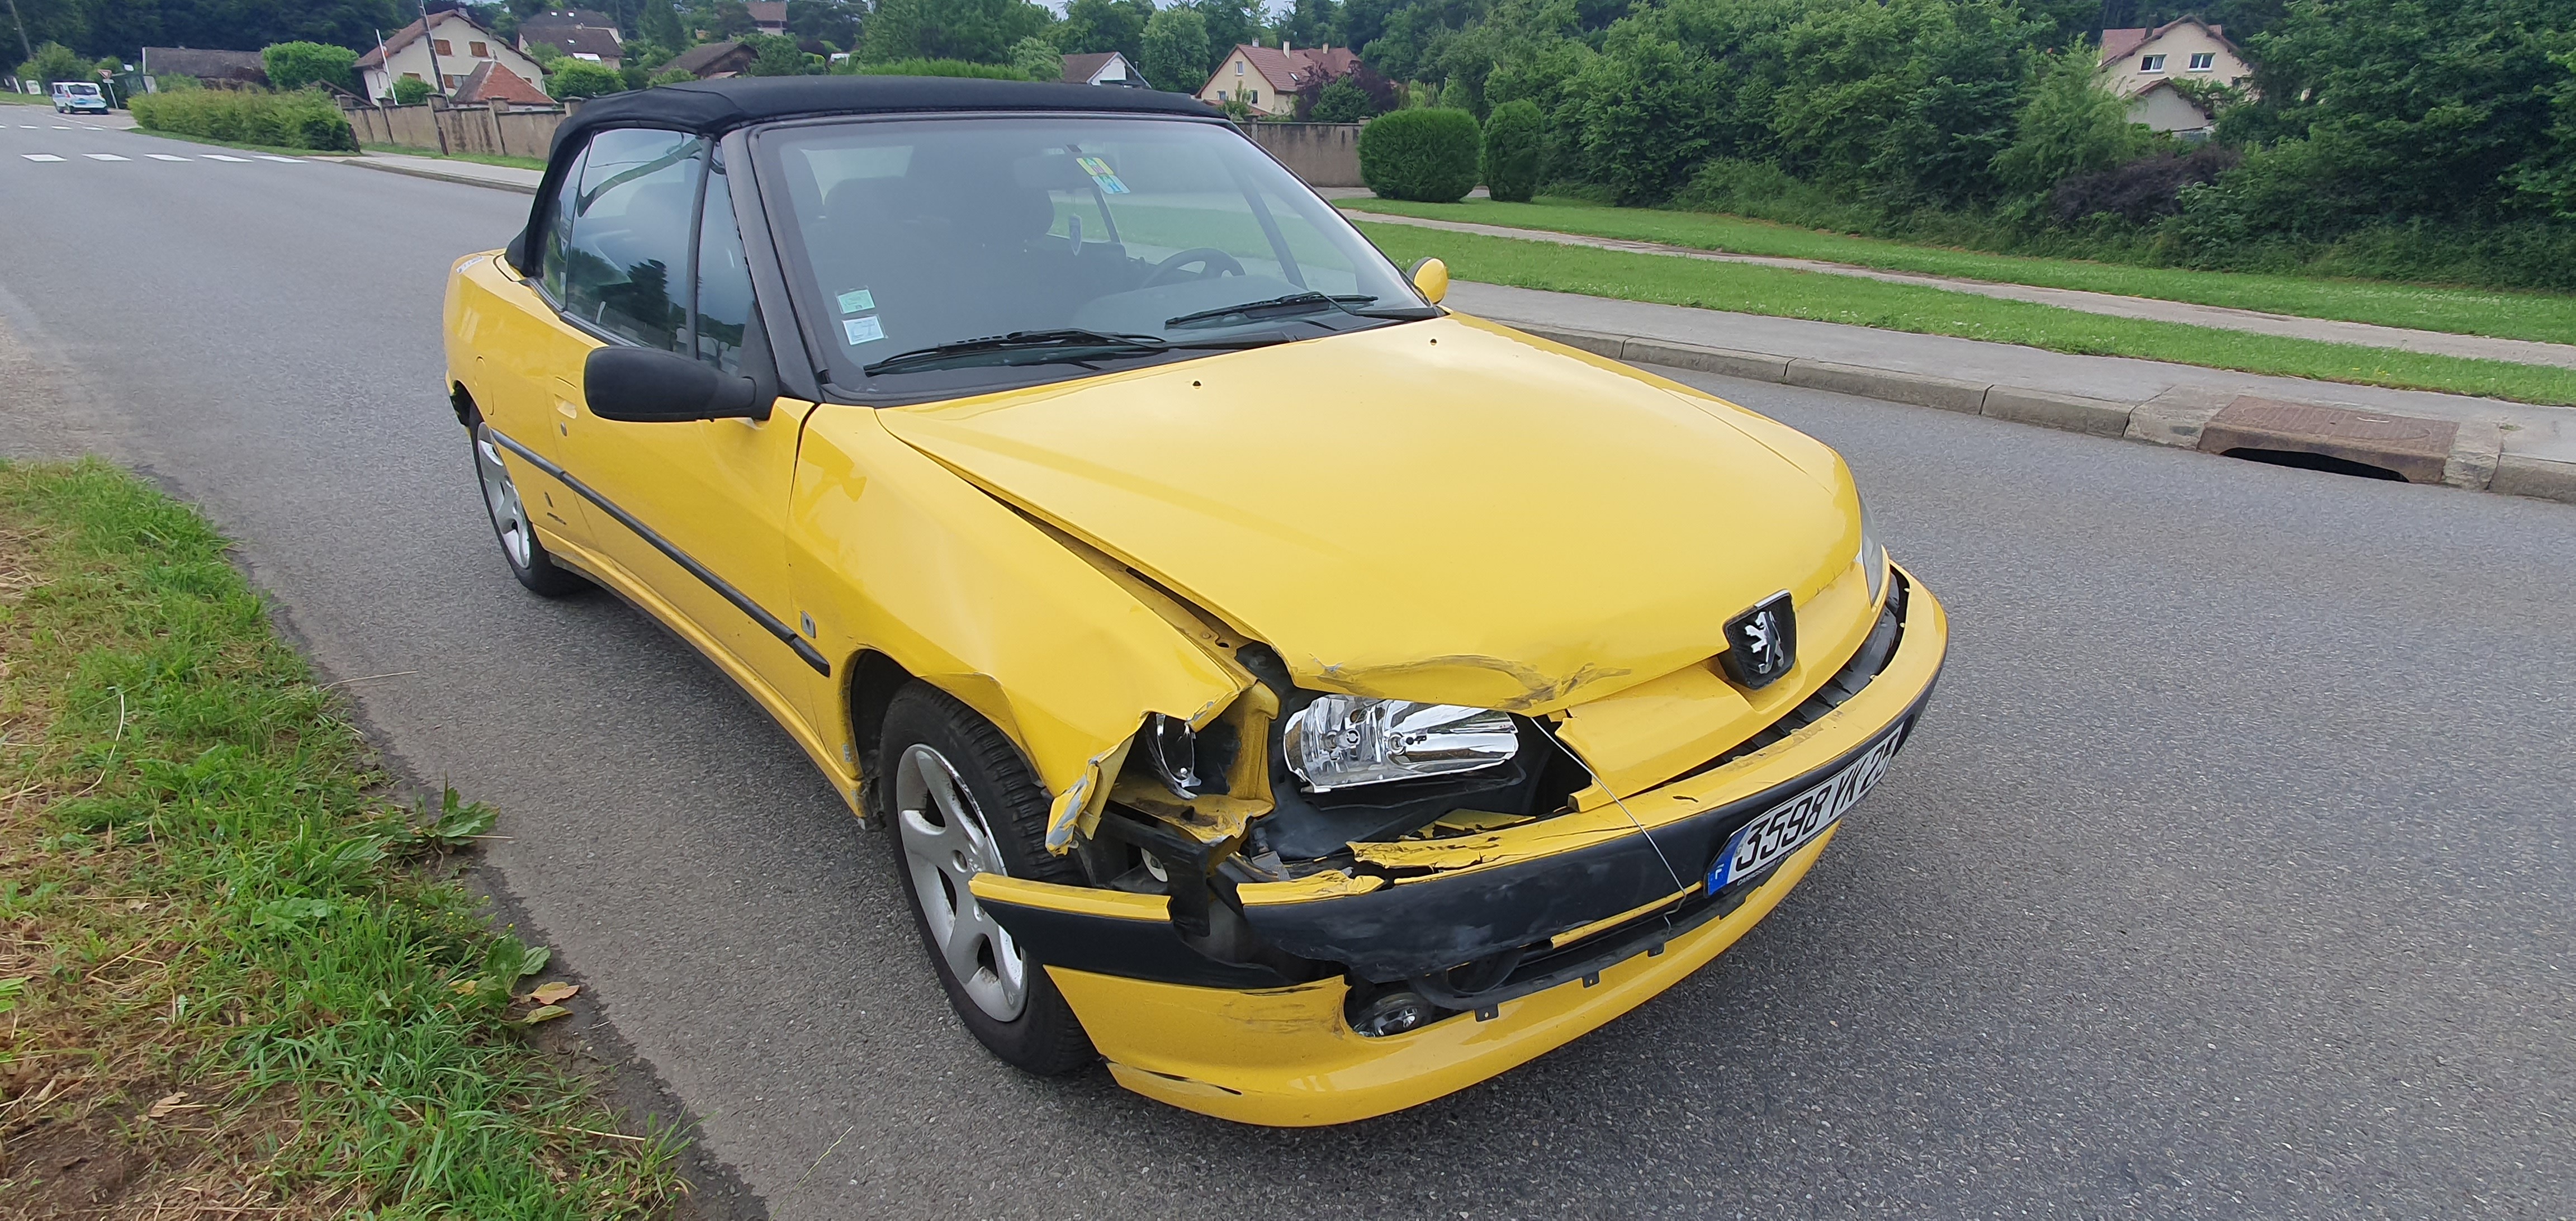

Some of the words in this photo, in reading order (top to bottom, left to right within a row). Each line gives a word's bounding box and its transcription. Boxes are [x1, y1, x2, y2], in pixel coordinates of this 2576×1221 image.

[1735, 784, 1833, 872] 3598
[1829, 756, 1869, 818] YK
[1858, 731, 1899, 794] 25
[1715, 863, 1725, 880] F
